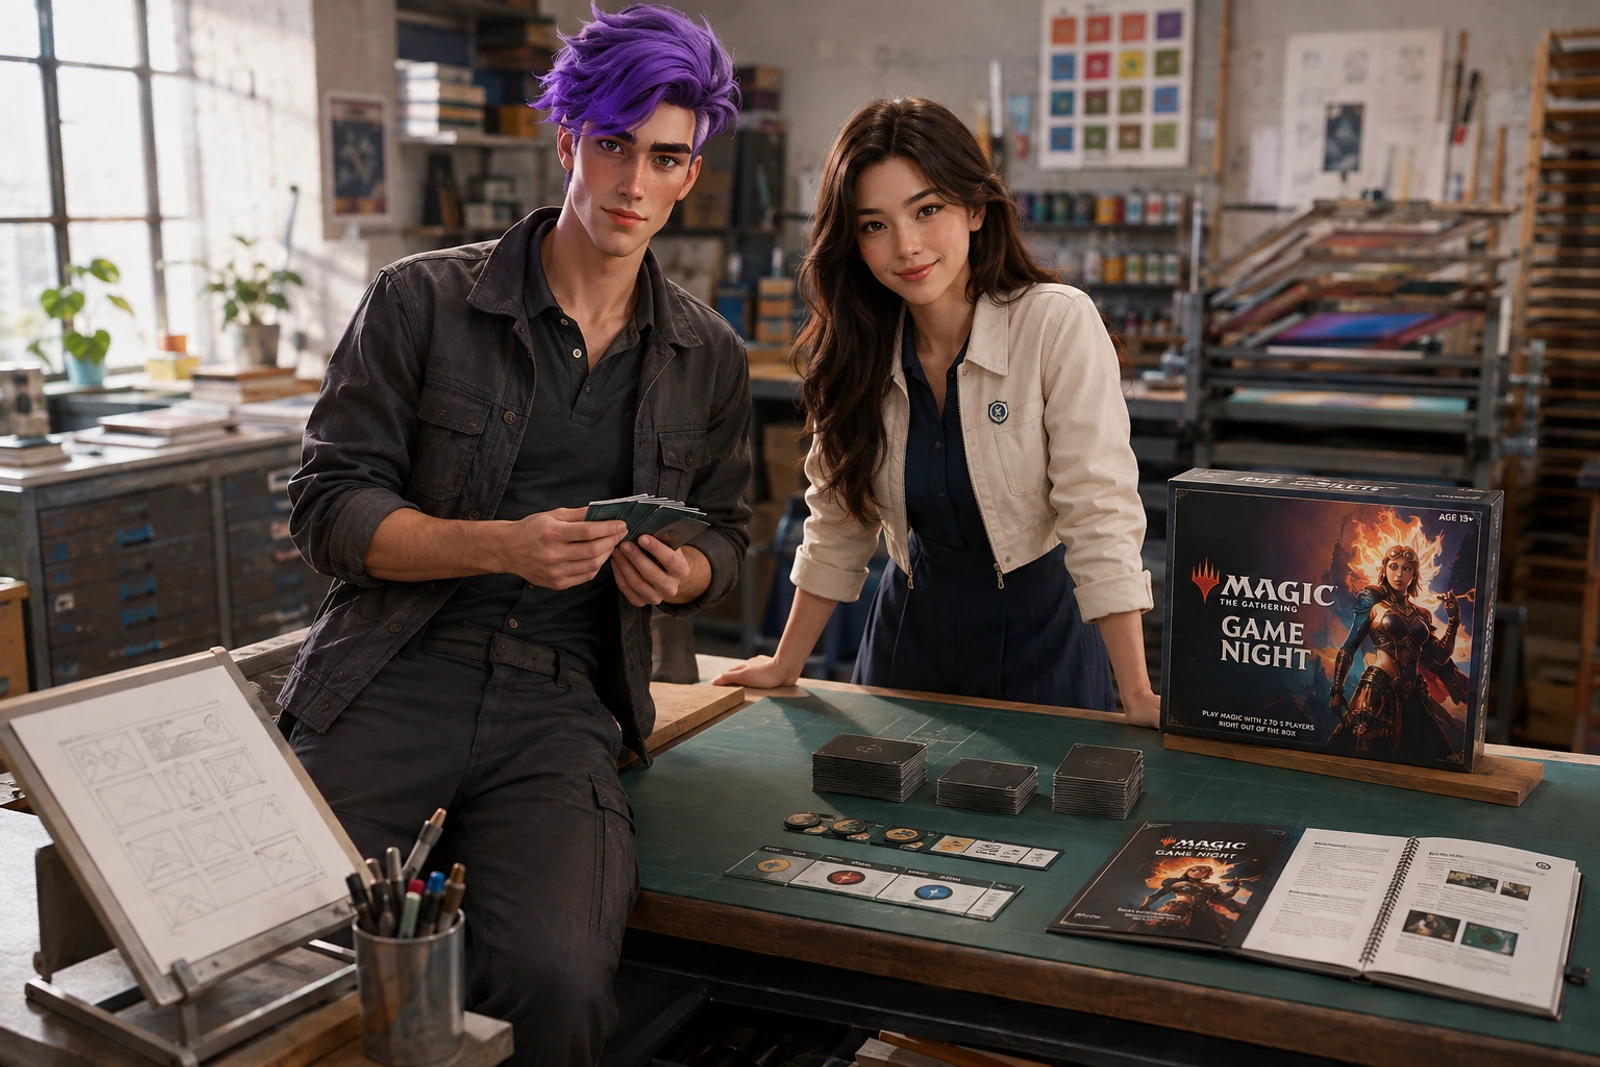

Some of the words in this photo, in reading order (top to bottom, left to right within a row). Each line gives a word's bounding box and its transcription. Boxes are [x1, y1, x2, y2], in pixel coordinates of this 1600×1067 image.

[1439, 513, 1457, 522] AGE
[1220, 574, 1335, 607] MAGIC
[1220, 598, 1238, 607] THE
[1241, 601, 1298, 613] GATHERING
[1221, 615, 1304, 645] GAME
[1220, 639, 1311, 670] NIGHT
[1202, 709, 1219, 719] PLAY
[1220, 712, 1242, 722] MAGIC
[1243, 715, 1262, 725] WITH
[1285, 720, 1315, 731] PLAYERS
[1240, 723, 1255, 732] OUT
[1281, 729, 1297, 737] BOX
[1175, 839, 1247, 850] MAGIC
[1155, 849, 1192, 857] GAME
